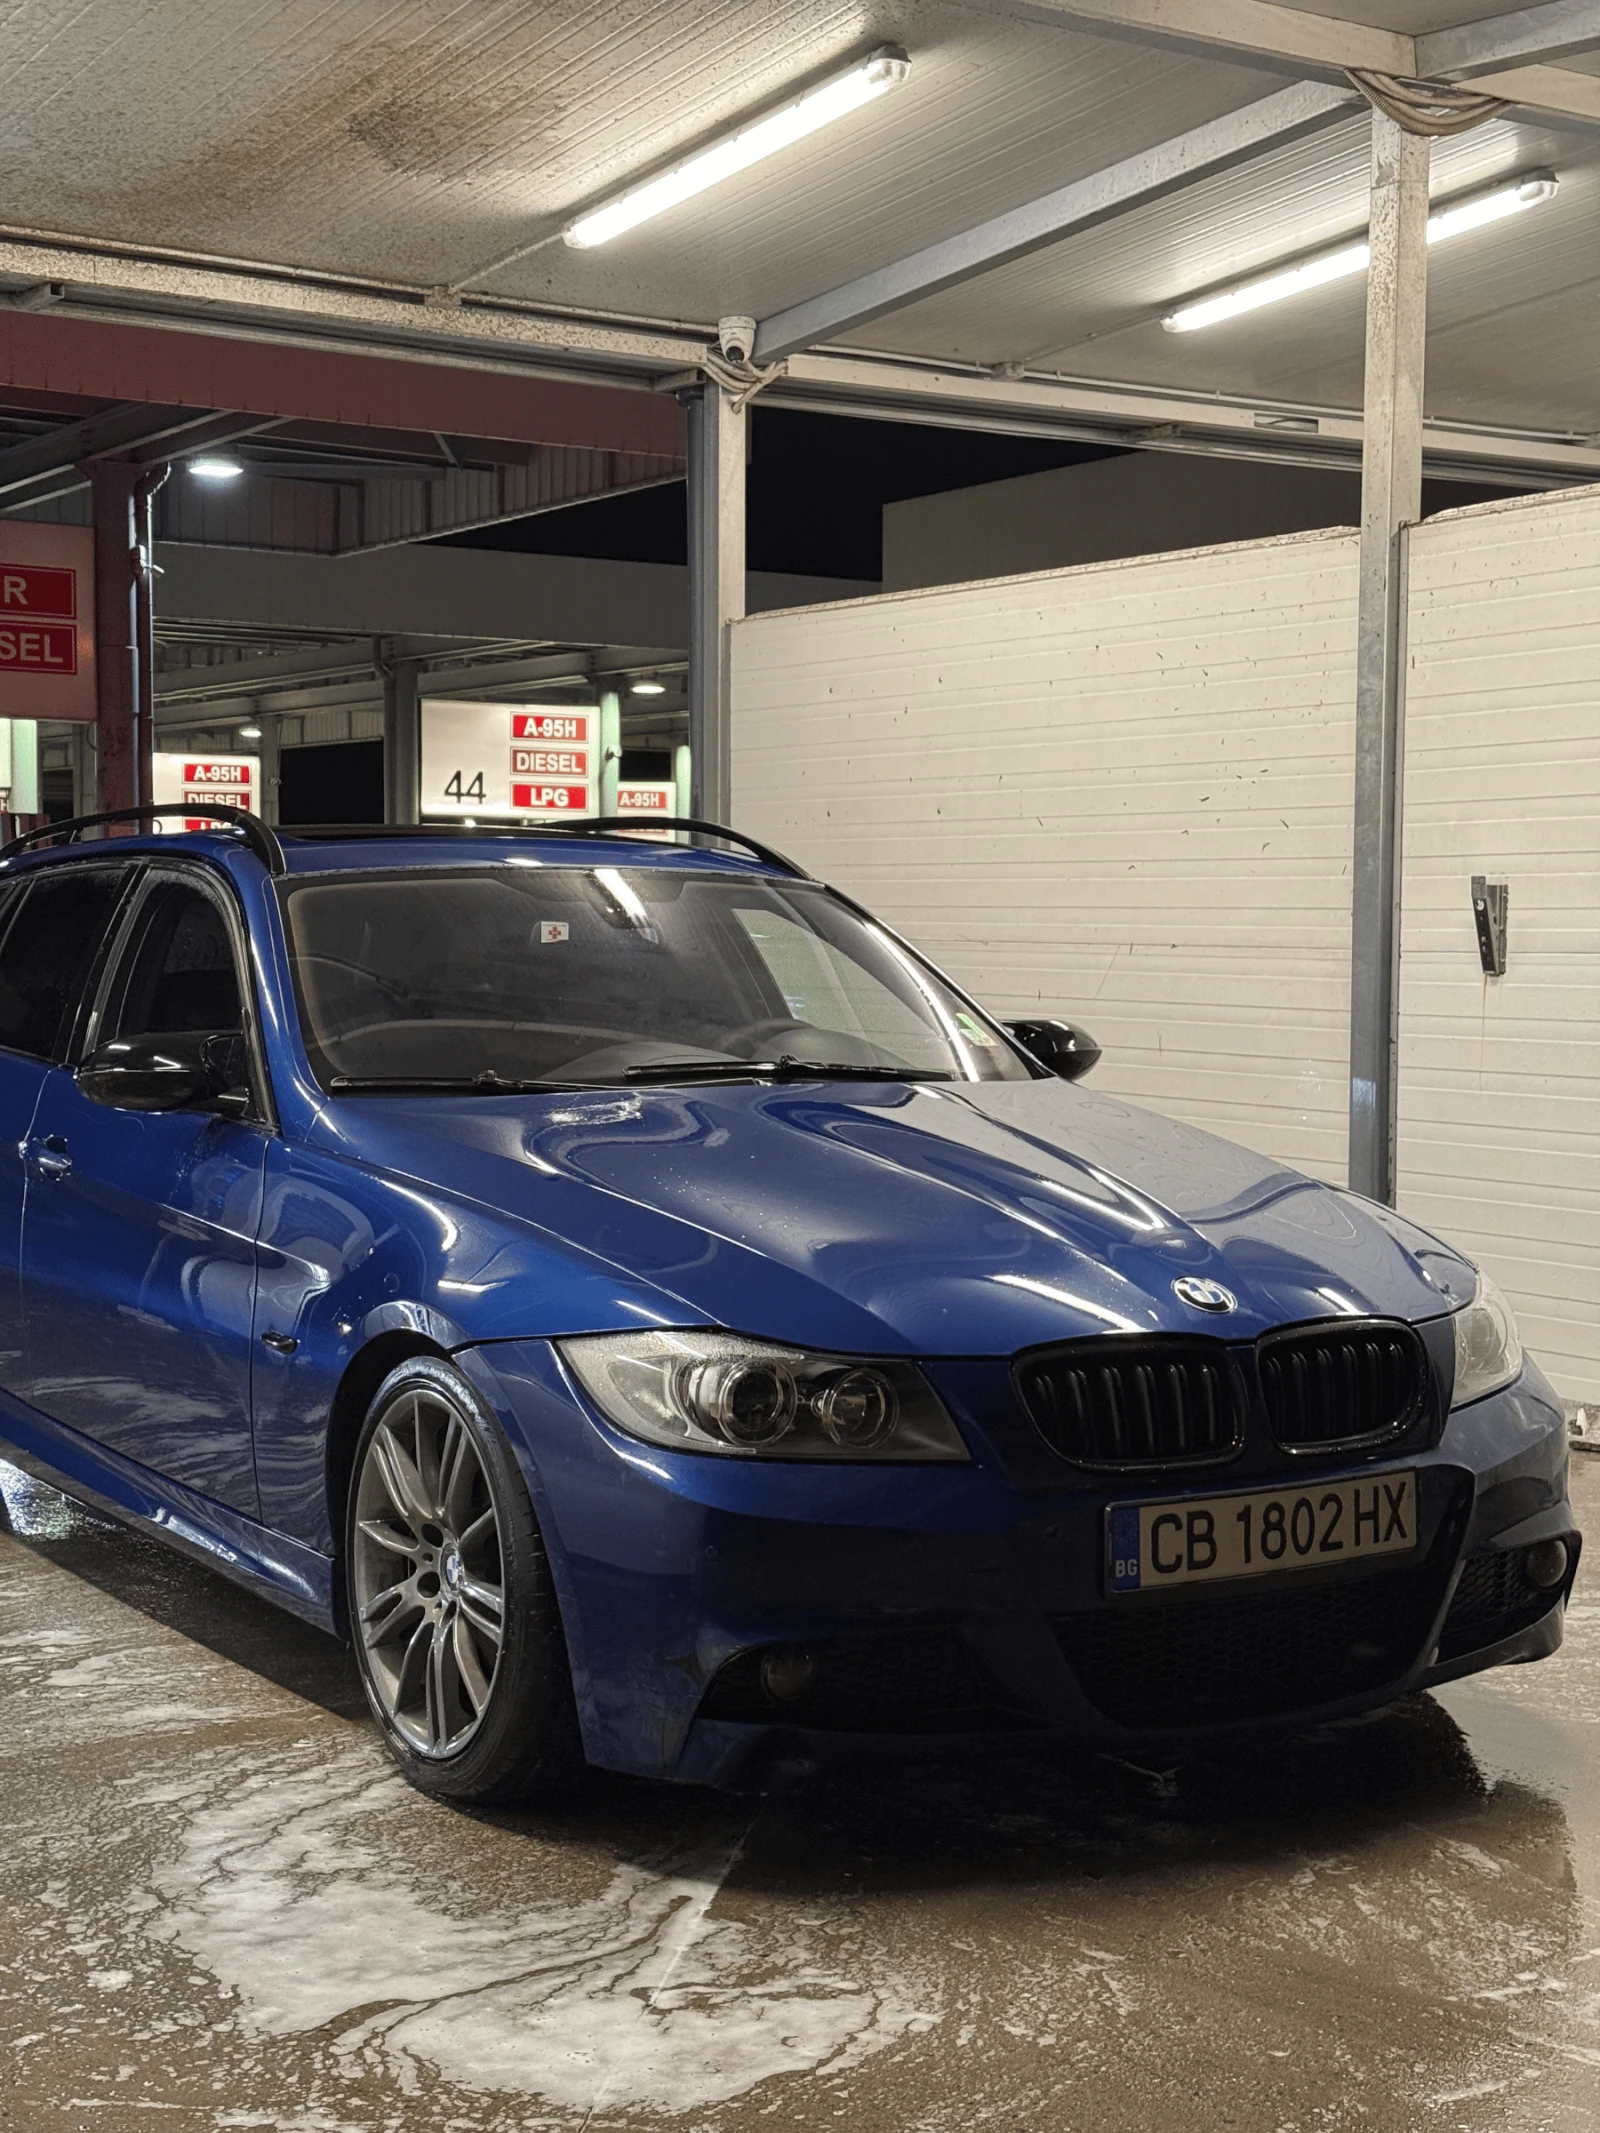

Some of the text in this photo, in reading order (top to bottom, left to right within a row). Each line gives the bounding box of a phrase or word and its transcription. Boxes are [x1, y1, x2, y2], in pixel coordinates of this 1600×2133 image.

[523, 717, 577, 738] A-95H
[193, 763, 242, 782] A-95H
[516, 752, 583, 773] DIESEL
[444, 770, 486, 804] 44
[530, 788, 569, 806] LPG
[620, 791, 660, 807] A-95H
[1150, 1510, 1217, 1574] CB
[1236, 1493, 1344, 1564] 1802
[1115, 1559, 1138, 1578] BG
